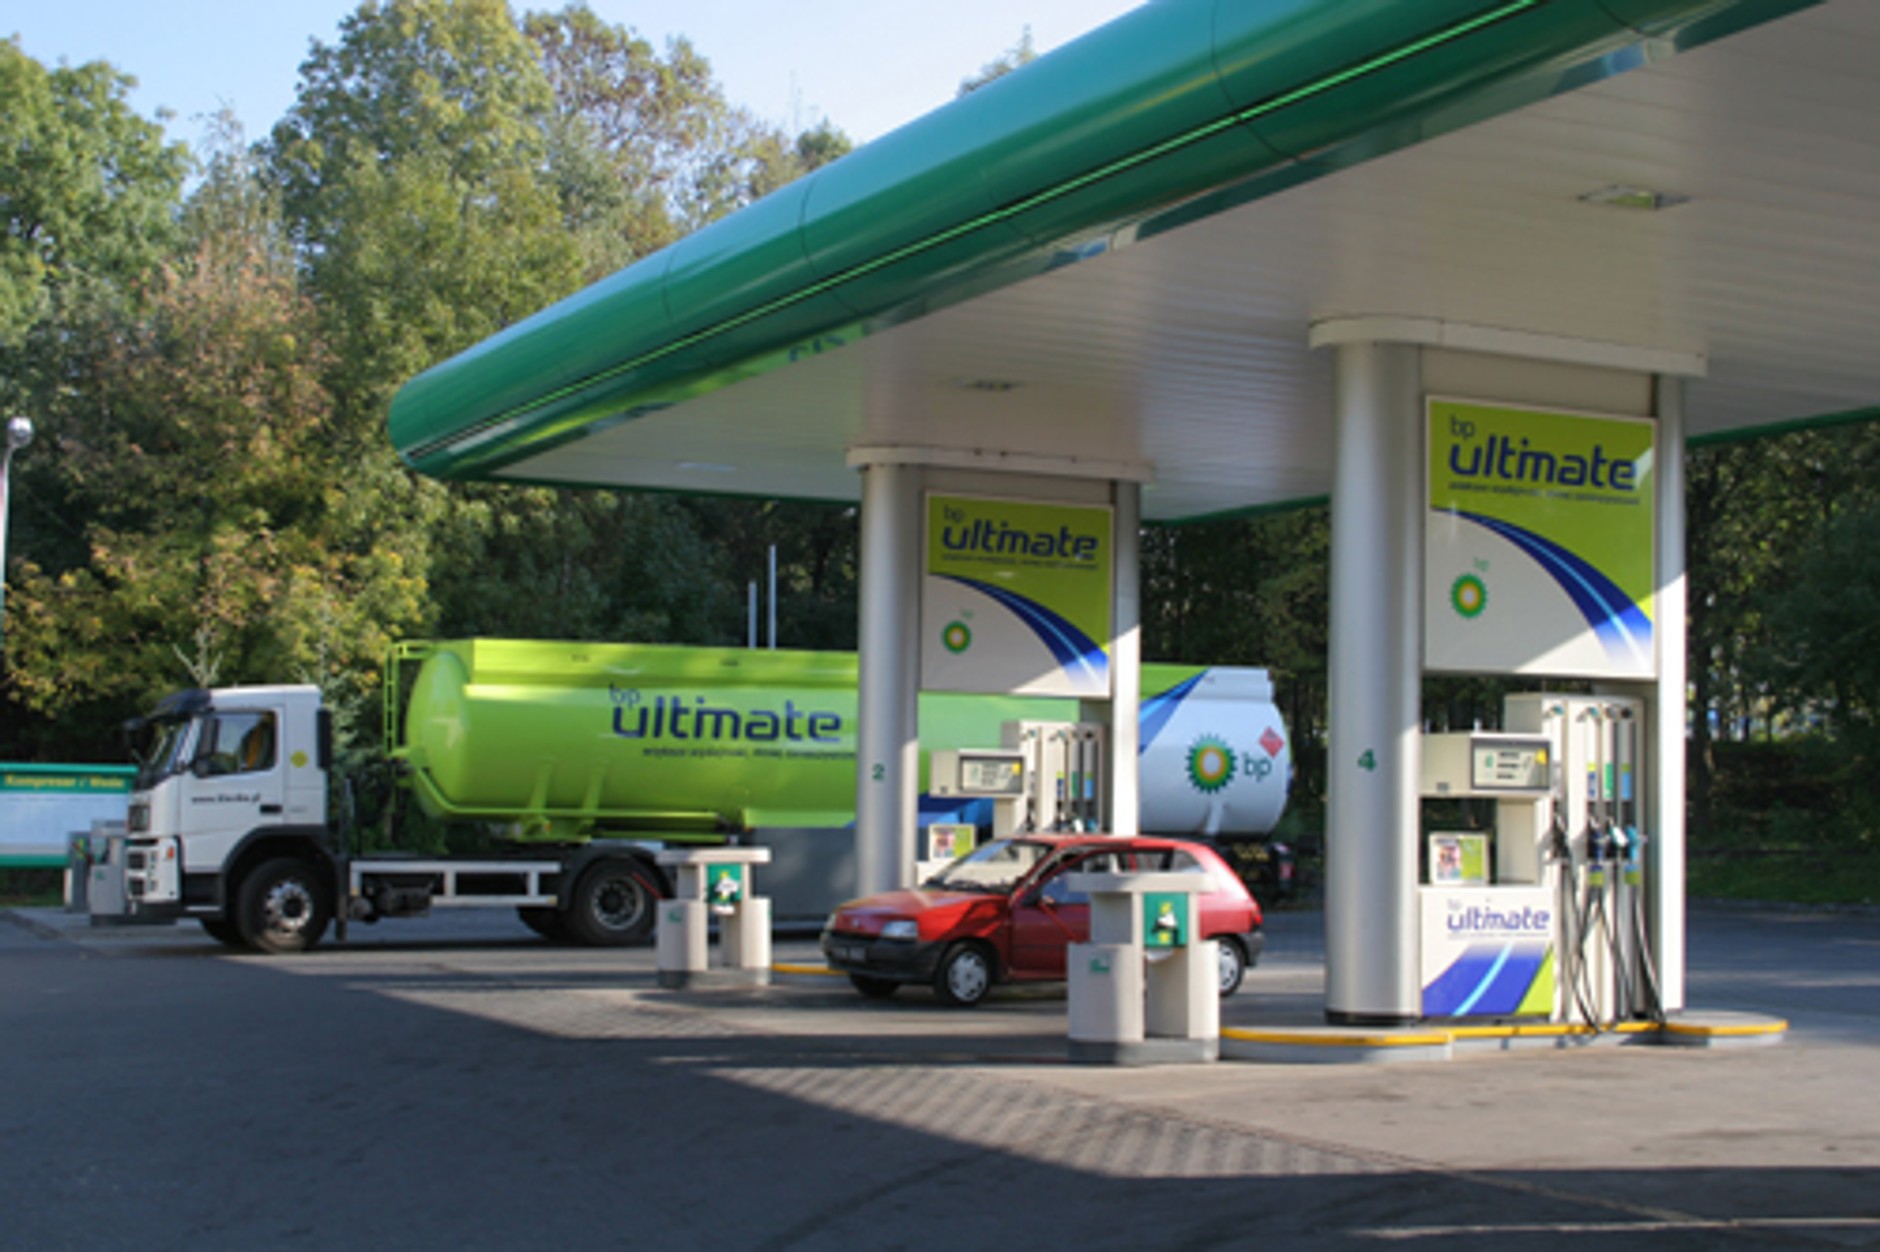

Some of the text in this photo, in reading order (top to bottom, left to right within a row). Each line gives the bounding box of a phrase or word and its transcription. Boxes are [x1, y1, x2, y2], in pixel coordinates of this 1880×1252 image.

[1450, 415, 1475, 440] bp
[1449, 434, 1637, 491] ultimate
[943, 519, 1098, 560] ultimate
[610, 683, 641, 709] bp
[612, 696, 842, 742] ultimate
[872, 763, 885, 782] 2
[1242, 752, 1272, 783] bp
[1357, 748, 1377, 772] 4
[1447, 906, 1550, 930] ultimate
